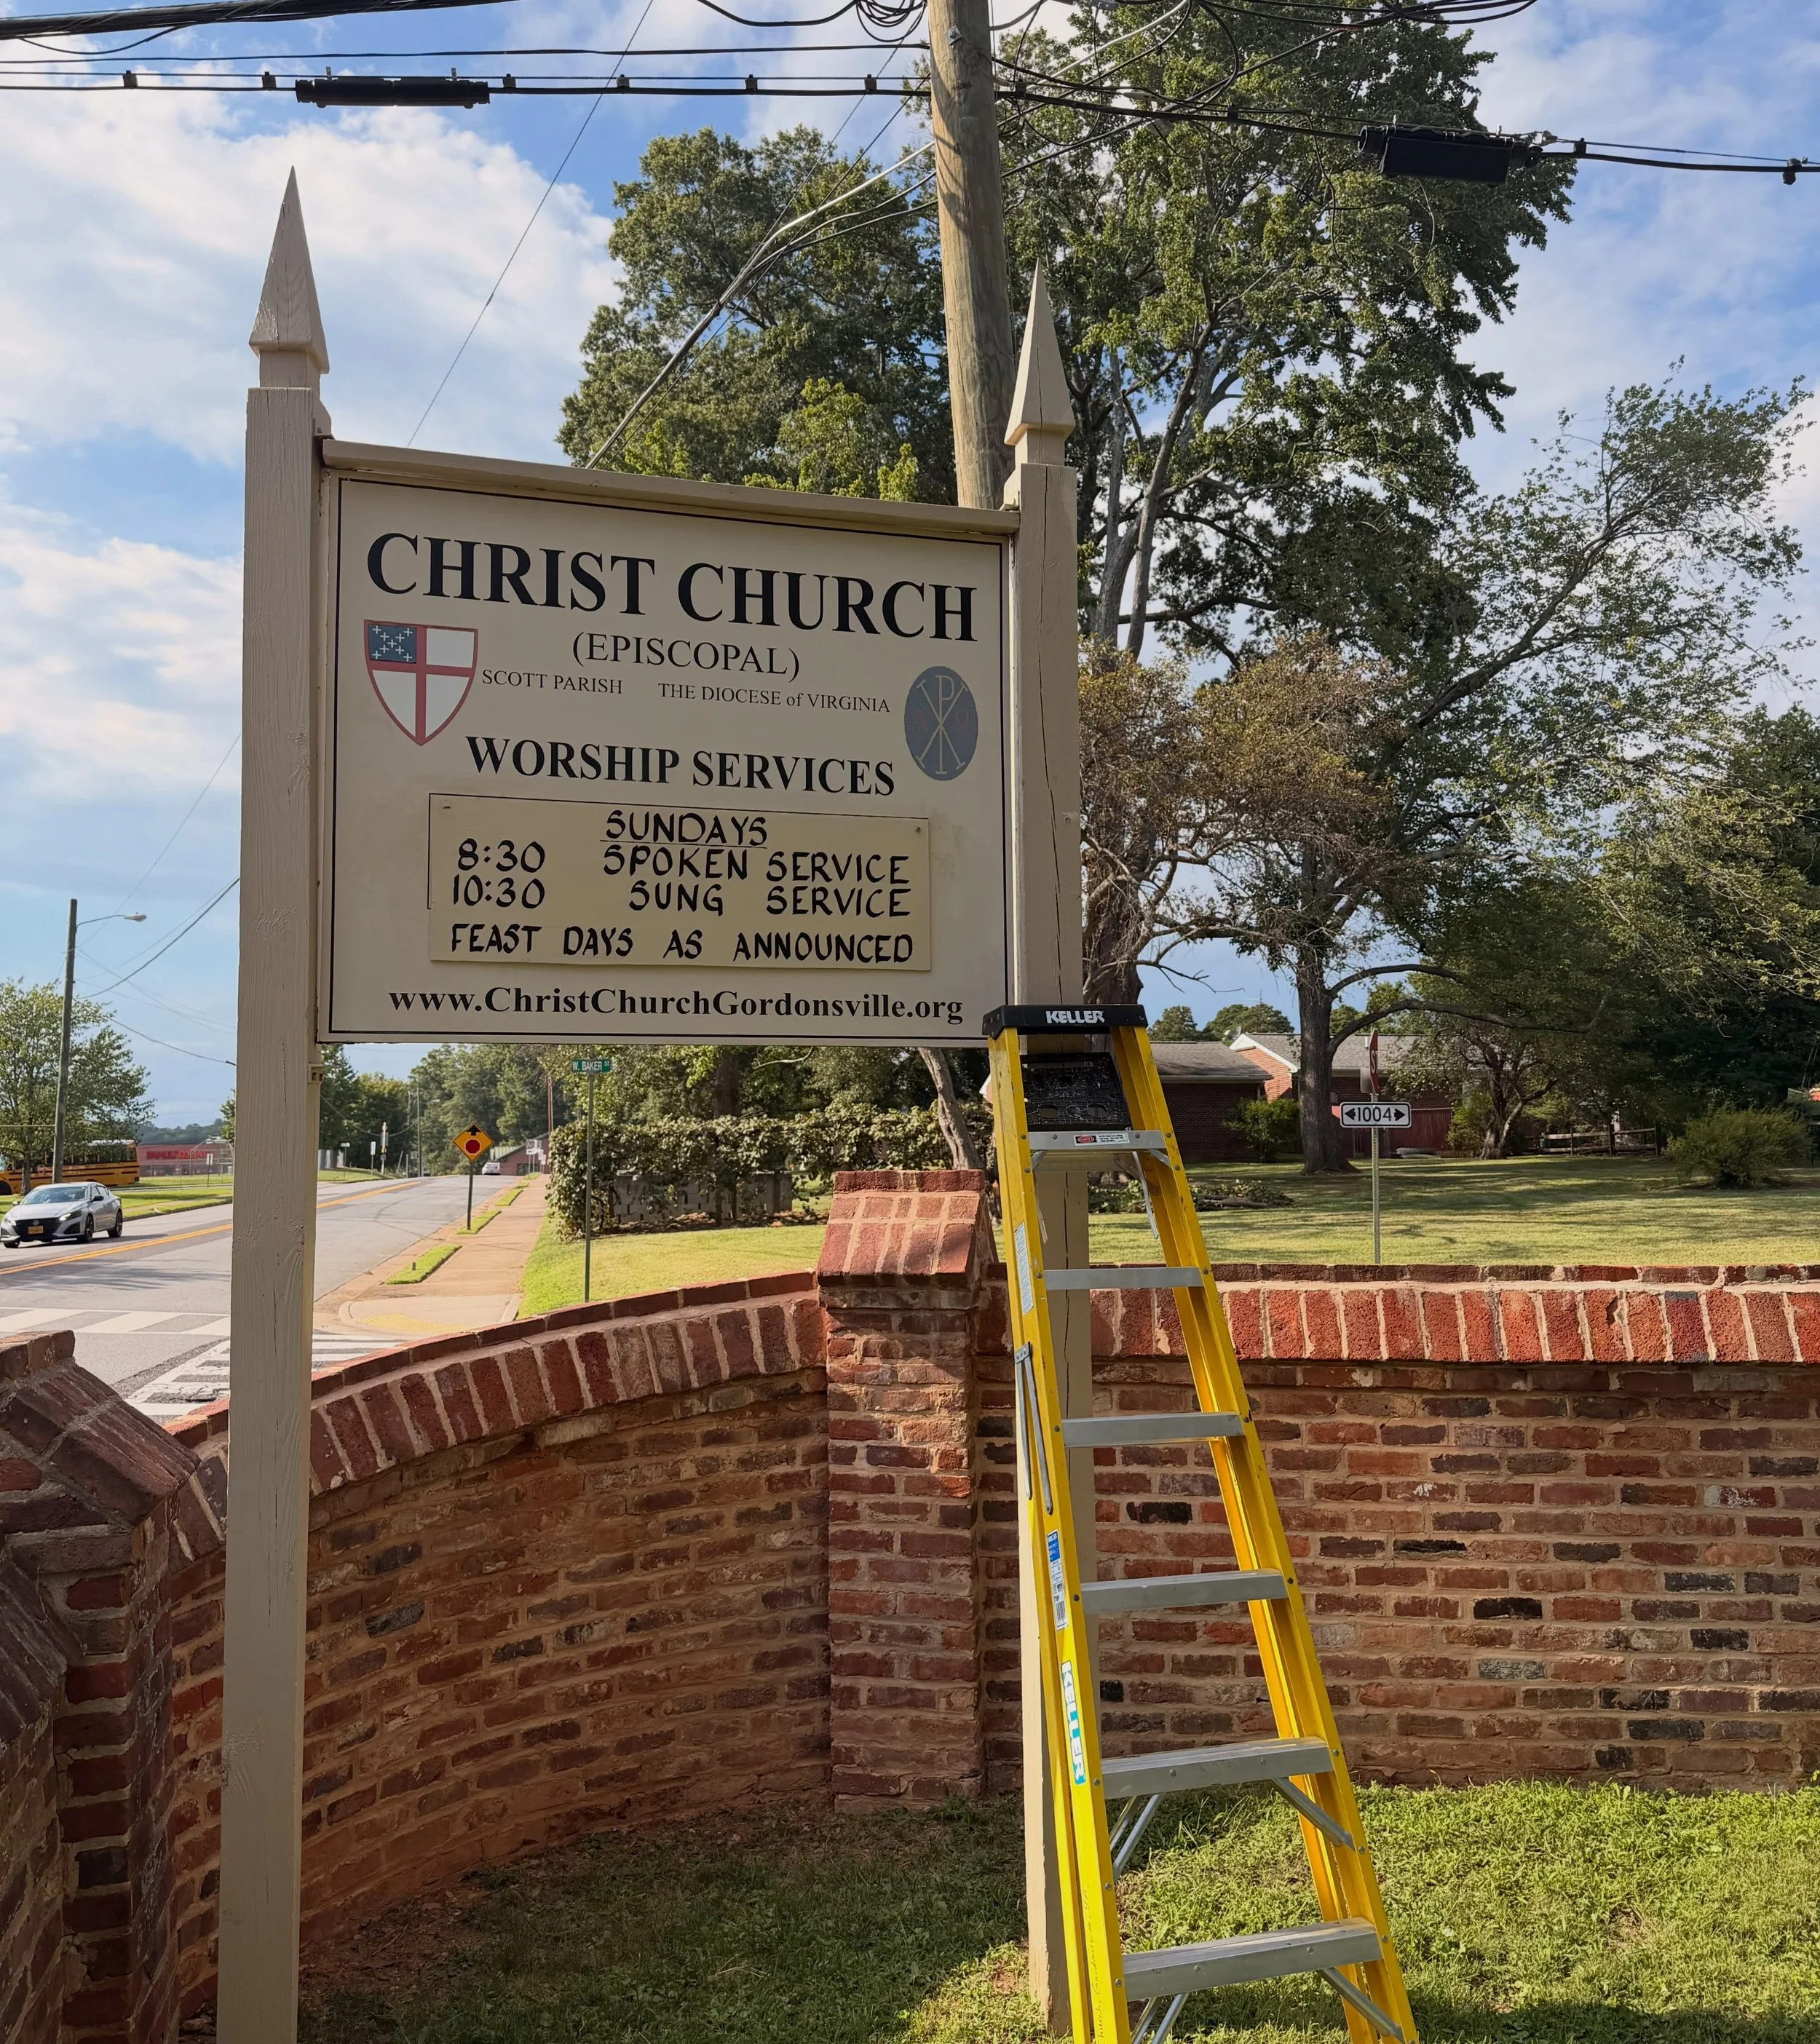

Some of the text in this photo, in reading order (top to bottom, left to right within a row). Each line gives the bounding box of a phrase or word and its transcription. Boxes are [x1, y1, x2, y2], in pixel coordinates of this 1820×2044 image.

[368, 533, 978, 641] CHRIST CHURCH
[573, 632, 799, 682] (EPISCOPAL)
[483, 670, 622, 694] SCOTT PARISH
[658, 683, 890, 712] THE DIOCESE of VIRGINIA
[465, 737, 894, 796] WORSHIP SERVICES
[606, 810, 767, 846] SUNDAYS
[458, 838, 545, 873] 8:30
[604, 845, 909, 884] SPOKEN SERVICE
[454, 874, 545, 908] 10:30
[629, 880, 911, 918] SUNG SERVICE
[452, 924, 912, 964] FEAST DAYS AS ANNOUNCED
[389, 987, 962, 1025] www.ChristChurchGordonsville.org
[1045, 1010, 1105, 1023] KELLER
[582, 1061, 602, 1071] BAKER
[1357, 1107, 1391, 1122] 1004
[1061, 1660, 1086, 1784] KELLER
